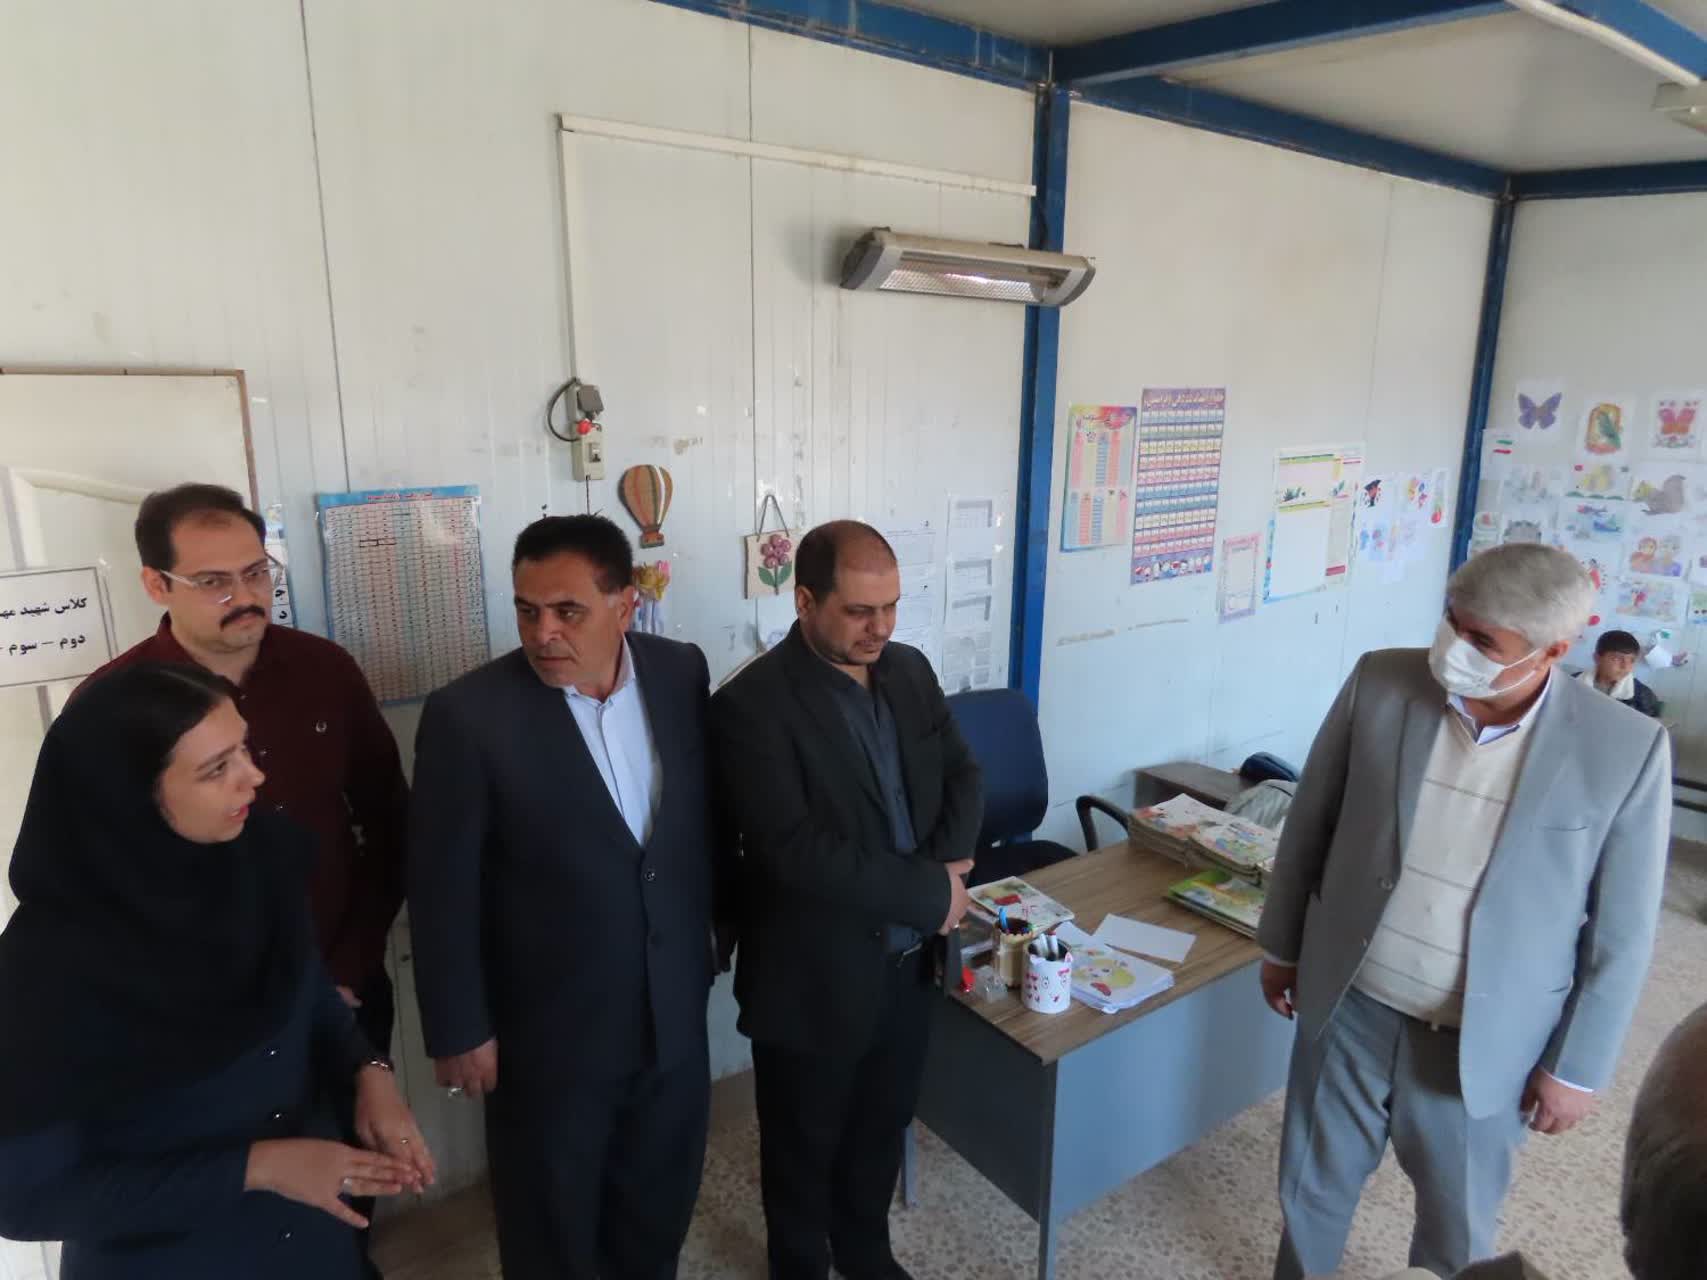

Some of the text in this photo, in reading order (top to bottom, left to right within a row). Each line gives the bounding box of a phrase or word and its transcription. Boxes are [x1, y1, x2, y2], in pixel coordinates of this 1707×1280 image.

[20, 602, 50, 617] شهید
[54, 597, 87, 614] کلاس
[8, 642, 37, 656] سوم
[60, 634, 86, 650] دوم
